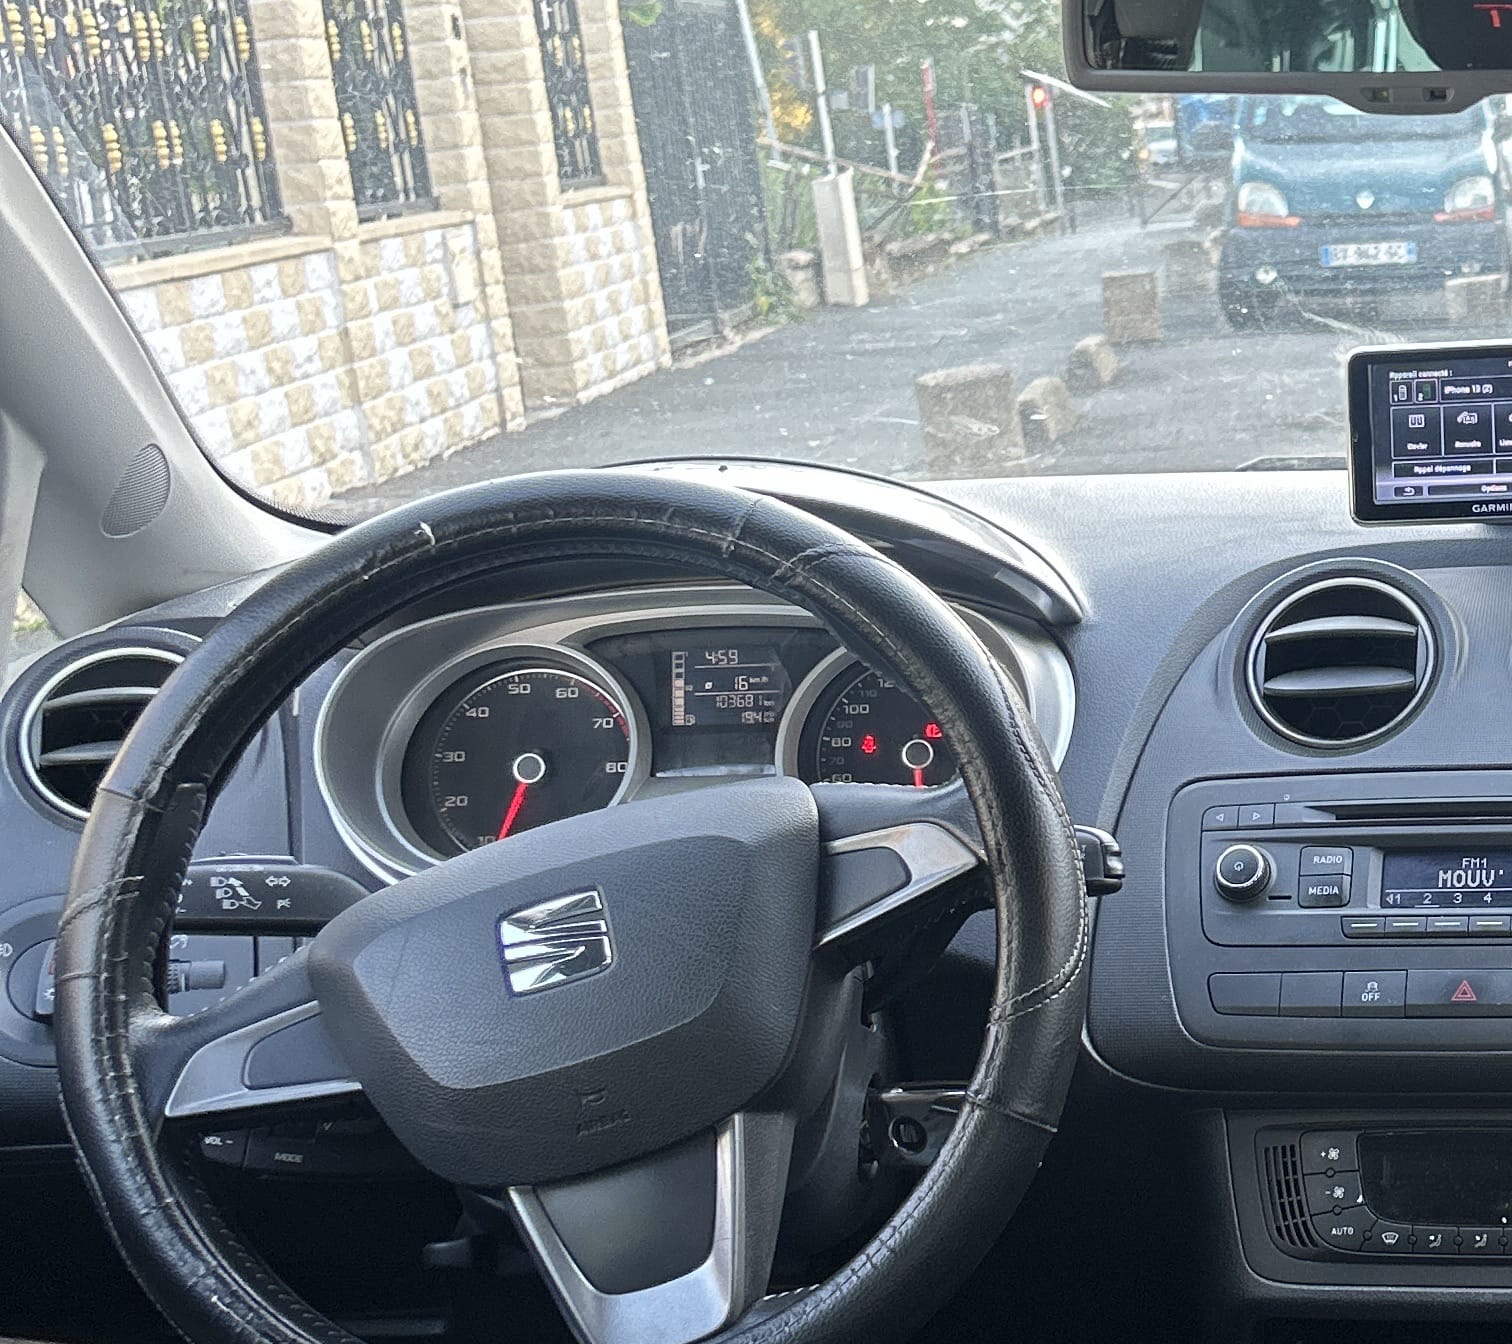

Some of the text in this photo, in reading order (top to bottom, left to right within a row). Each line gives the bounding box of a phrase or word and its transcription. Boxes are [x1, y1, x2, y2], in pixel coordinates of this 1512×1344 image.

[705, 649, 738, 665] 4:59
[507, 683, 531, 695] 50
[734, 676, 749, 691] 16
[555, 687, 579, 699] 60
[465, 707, 490, 718] 40
[842, 704, 870, 715] 100
[592, 717, 614, 729] 70
[831, 737, 852, 747] 80
[442, 751, 466, 762] 30
[605, 761, 628, 773] 80
[444, 796, 468, 807] 20
[1313, 855, 1343, 864] RADIO
[1462, 857, 1488, 869] FM1
[1308, 885, 1339, 895] MEDIA
[1423, 893, 1433, 904] 2
[1453, 892, 1463, 904] 3
[1483, 892, 1493, 903] 4
[1361, 992, 1381, 1002] OFF
[203, 1135, 224, 1146] VOL
[1330, 1226, 1354, 1237] AUTO
